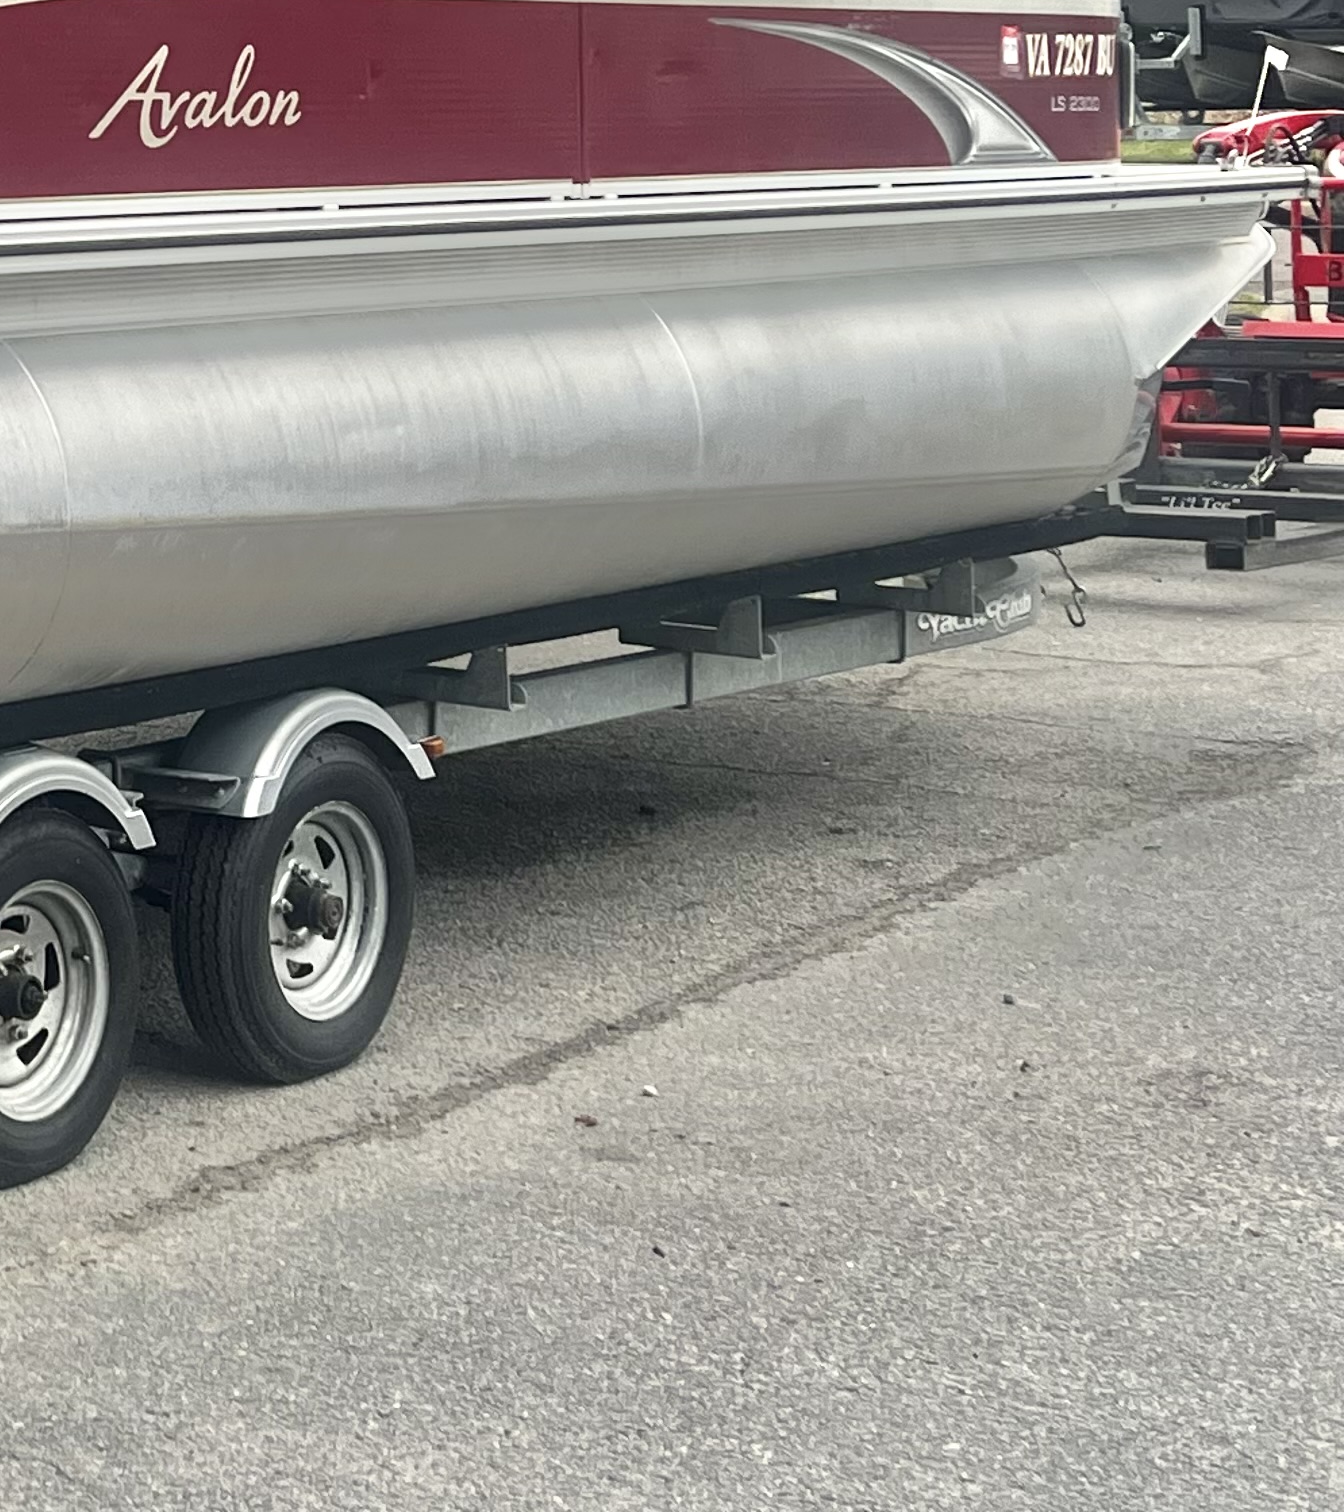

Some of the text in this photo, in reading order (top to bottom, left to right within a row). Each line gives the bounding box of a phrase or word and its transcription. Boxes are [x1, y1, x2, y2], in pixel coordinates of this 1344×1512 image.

[1025, 32, 1051, 78] VA
[1054, 33, 1094, 77] 7287
[88, 44, 302, 149] Avalon
[1051, 95, 1066, 112] LS
